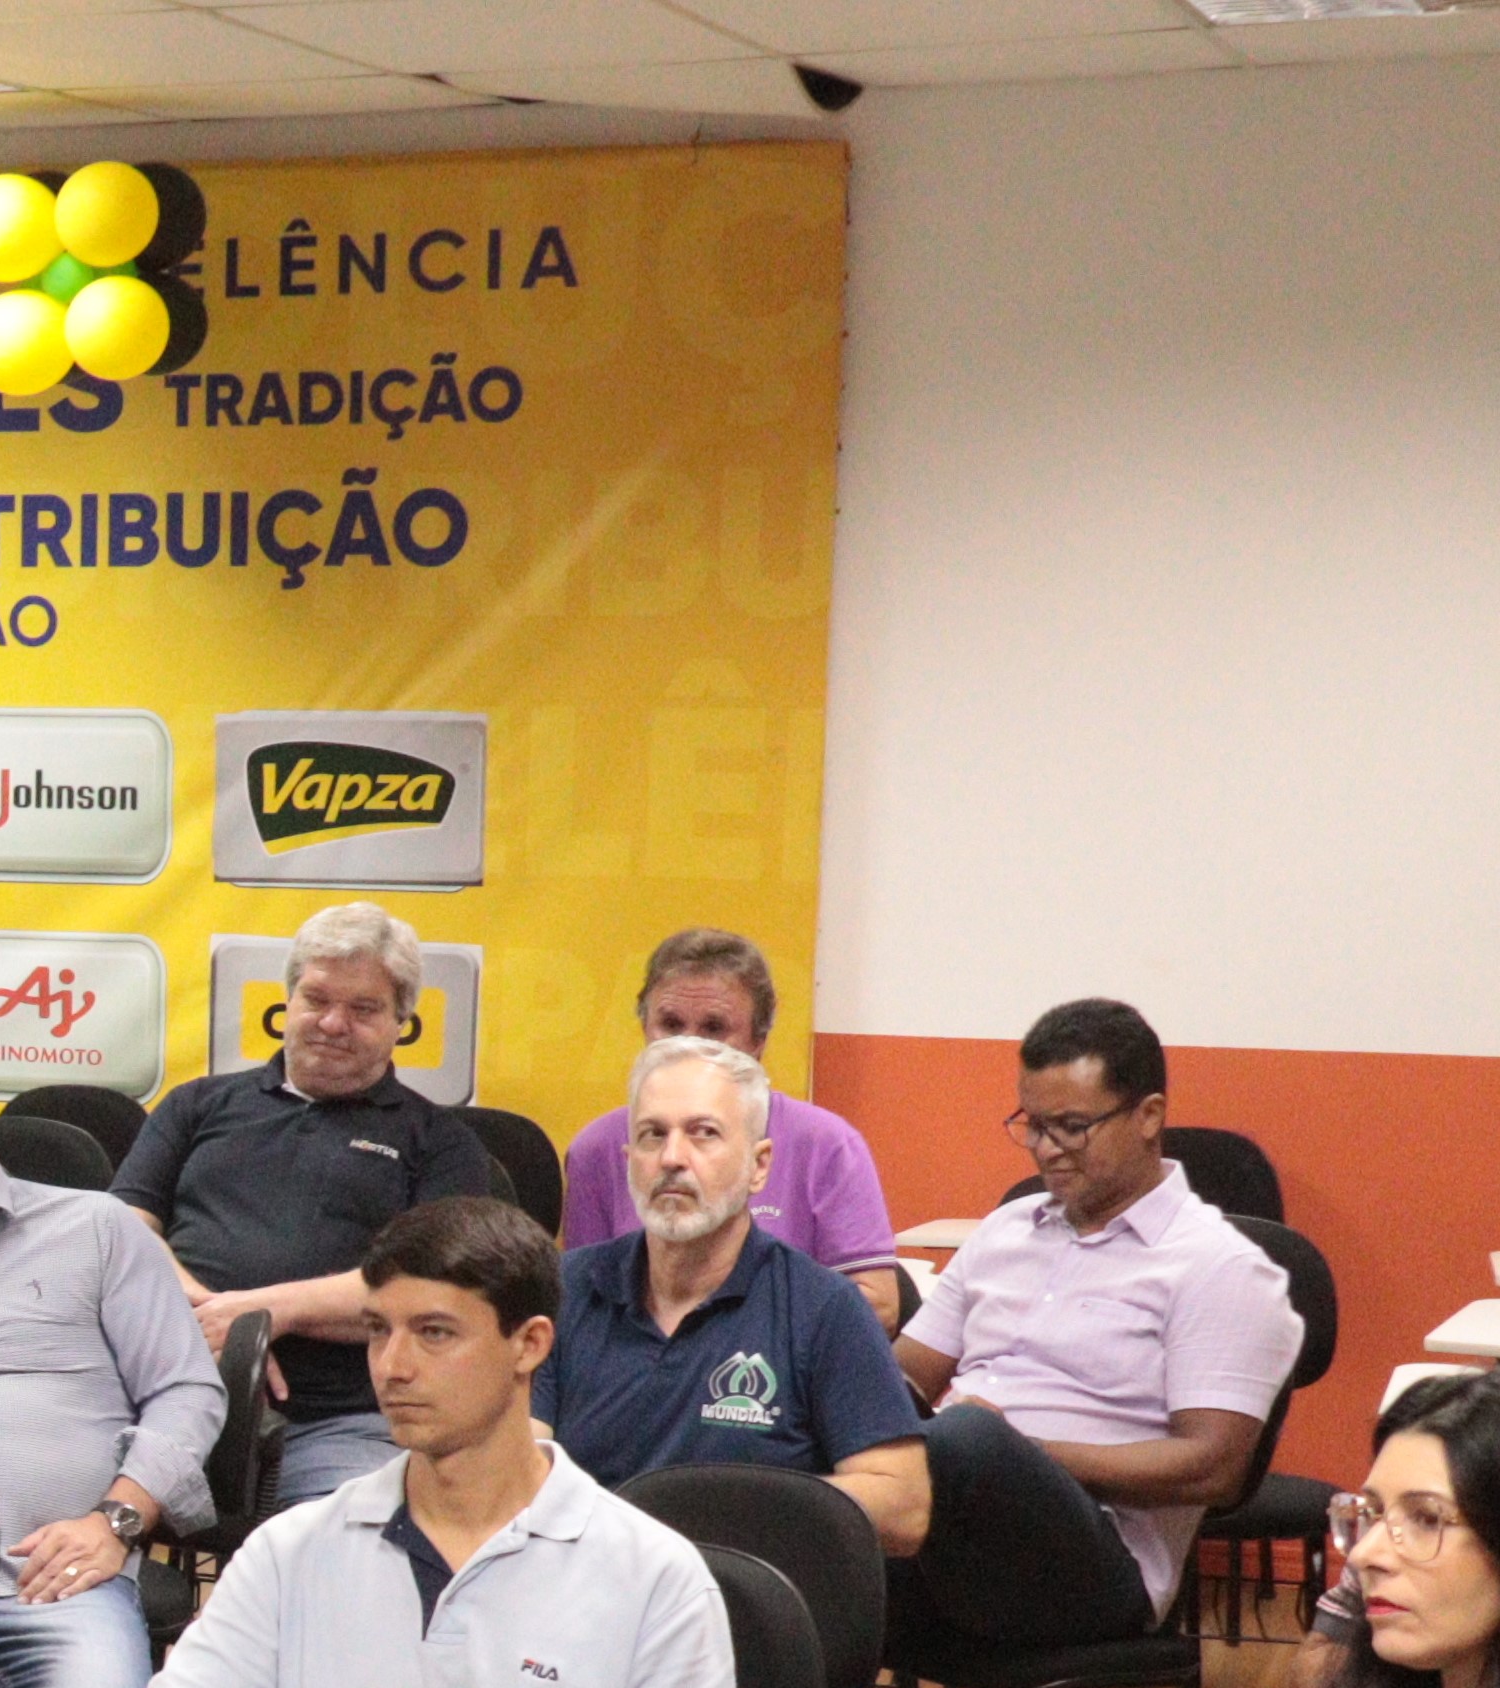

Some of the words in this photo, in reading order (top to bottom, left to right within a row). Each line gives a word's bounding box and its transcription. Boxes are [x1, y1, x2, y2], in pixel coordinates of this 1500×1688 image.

[164, 352, 523, 441] TRADIÇÃO
[262, 757, 443, 823] Vapza
[521, 1659, 559, 1681] FILA
